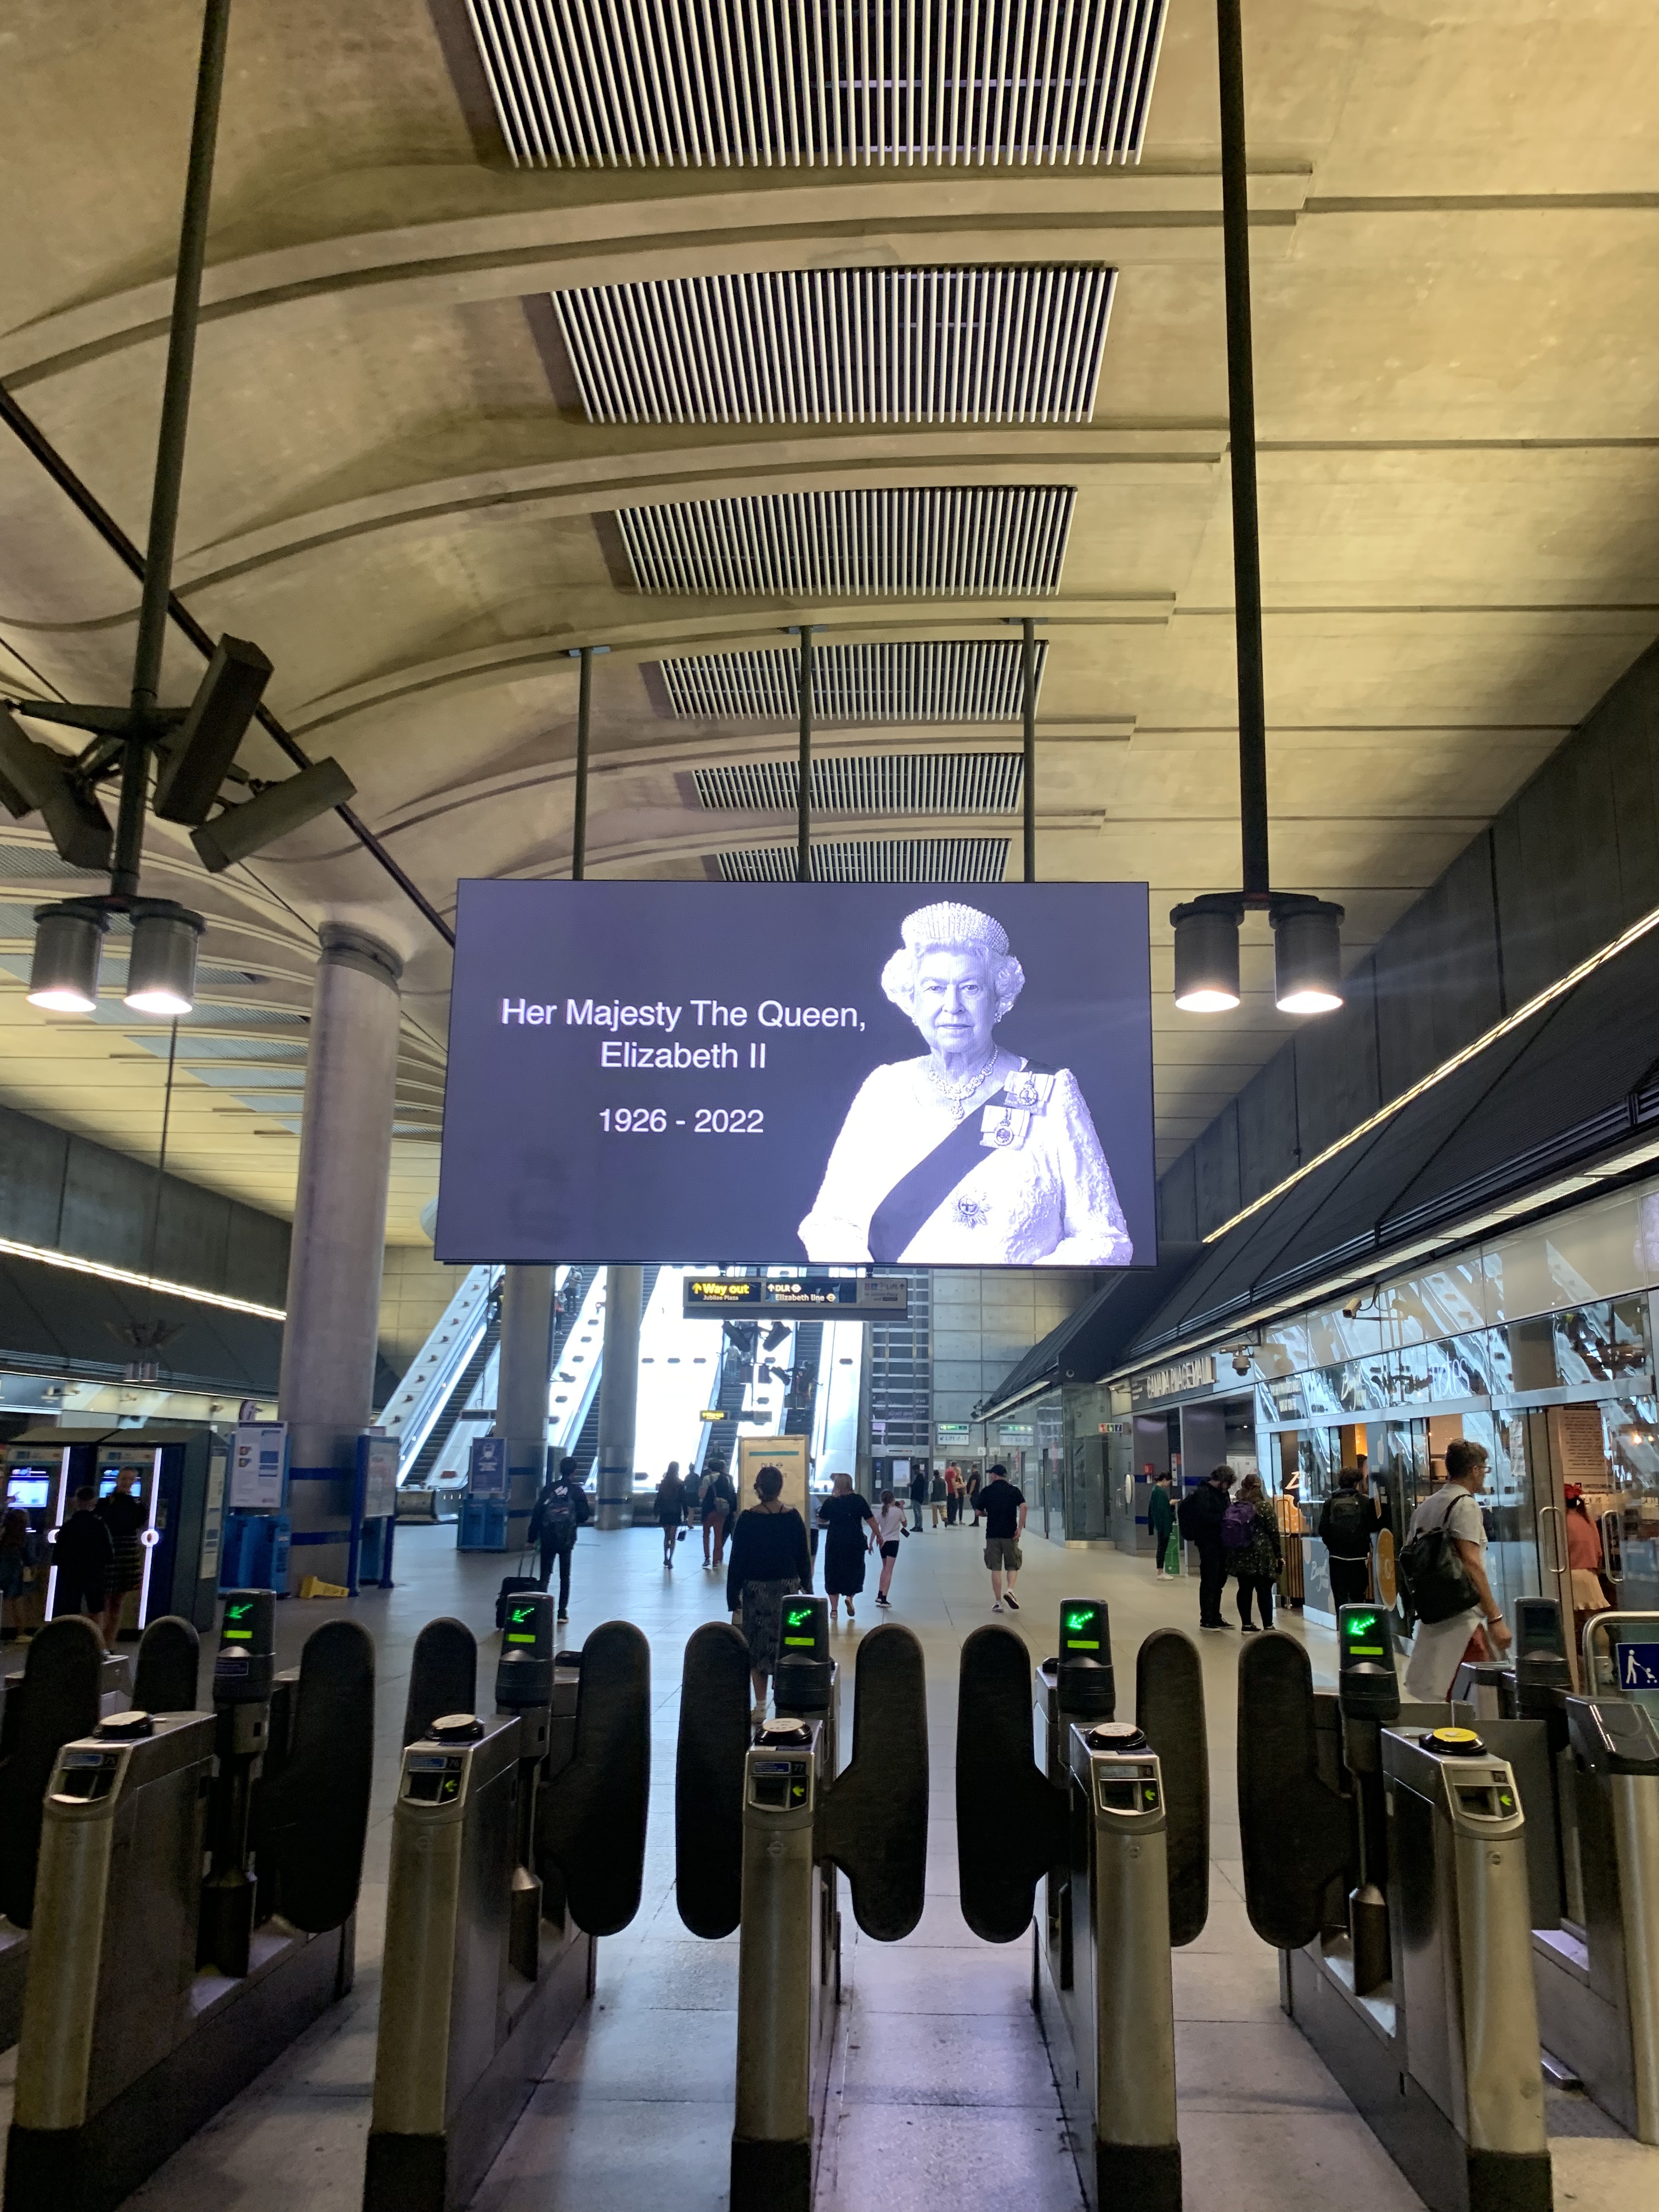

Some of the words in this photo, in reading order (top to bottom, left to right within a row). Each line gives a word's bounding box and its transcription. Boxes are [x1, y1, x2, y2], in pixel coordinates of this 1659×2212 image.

[502, 998, 557, 1025] Her
[566, 998, 682, 1032] Majesty
[690, 1000, 748, 1026] The
[758, 1000, 866, 1031] Queen,
[601, 1041, 738, 1069] Elizabeth
[750, 1042, 766, 1069] II
[599, 1108, 667, 1132] 1926
[693, 1109, 764, 1133] 2022
[702, 1284, 727, 1296] Way
[729, 1284, 749, 1294] out
[1147, 1369, 1170, 1399] CANADA
[1170, 1362, 1194, 1393] PLACE
